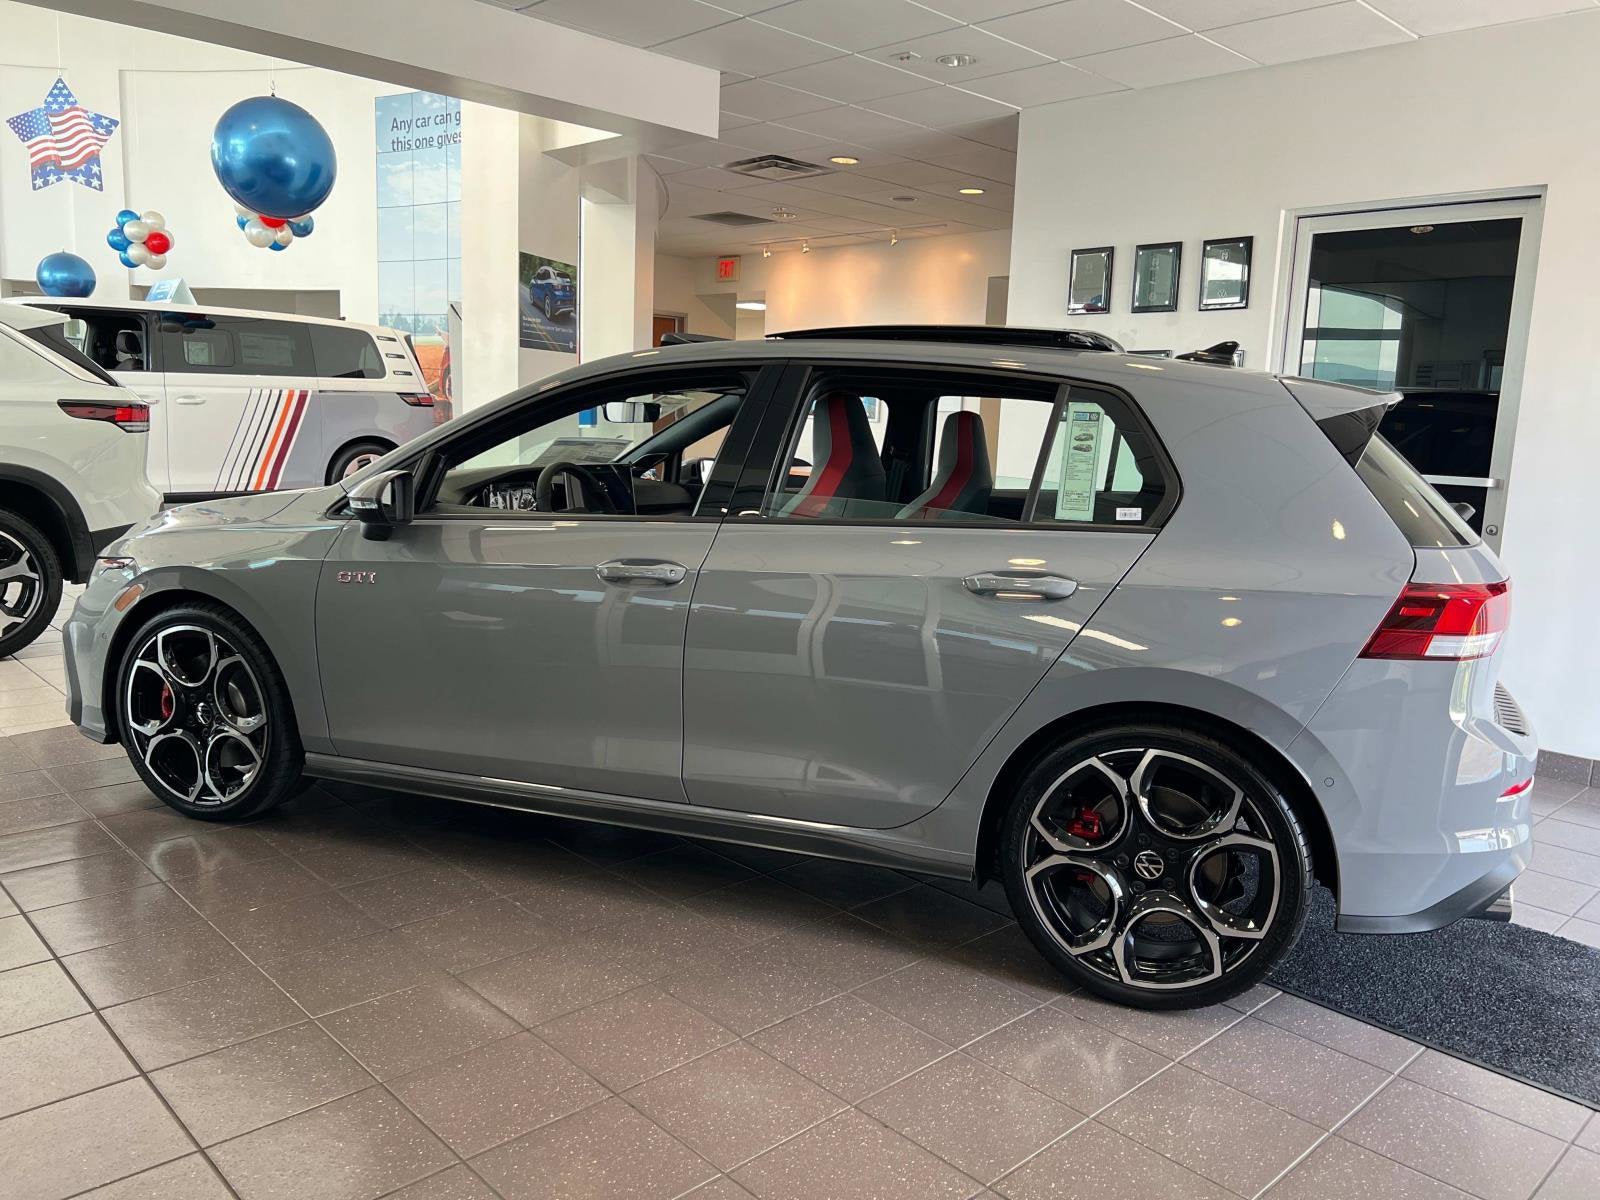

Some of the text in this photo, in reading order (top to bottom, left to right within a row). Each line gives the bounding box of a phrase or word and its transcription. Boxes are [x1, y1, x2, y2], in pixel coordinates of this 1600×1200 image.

[391, 117, 412, 133] Any
[415, 115, 431, 128] car
[434, 112, 451, 126] can
[391, 136, 411, 152] this
[415, 136, 434, 149] one
[719, 260, 736, 279] EXIT
[337, 571, 376, 584] GTI
